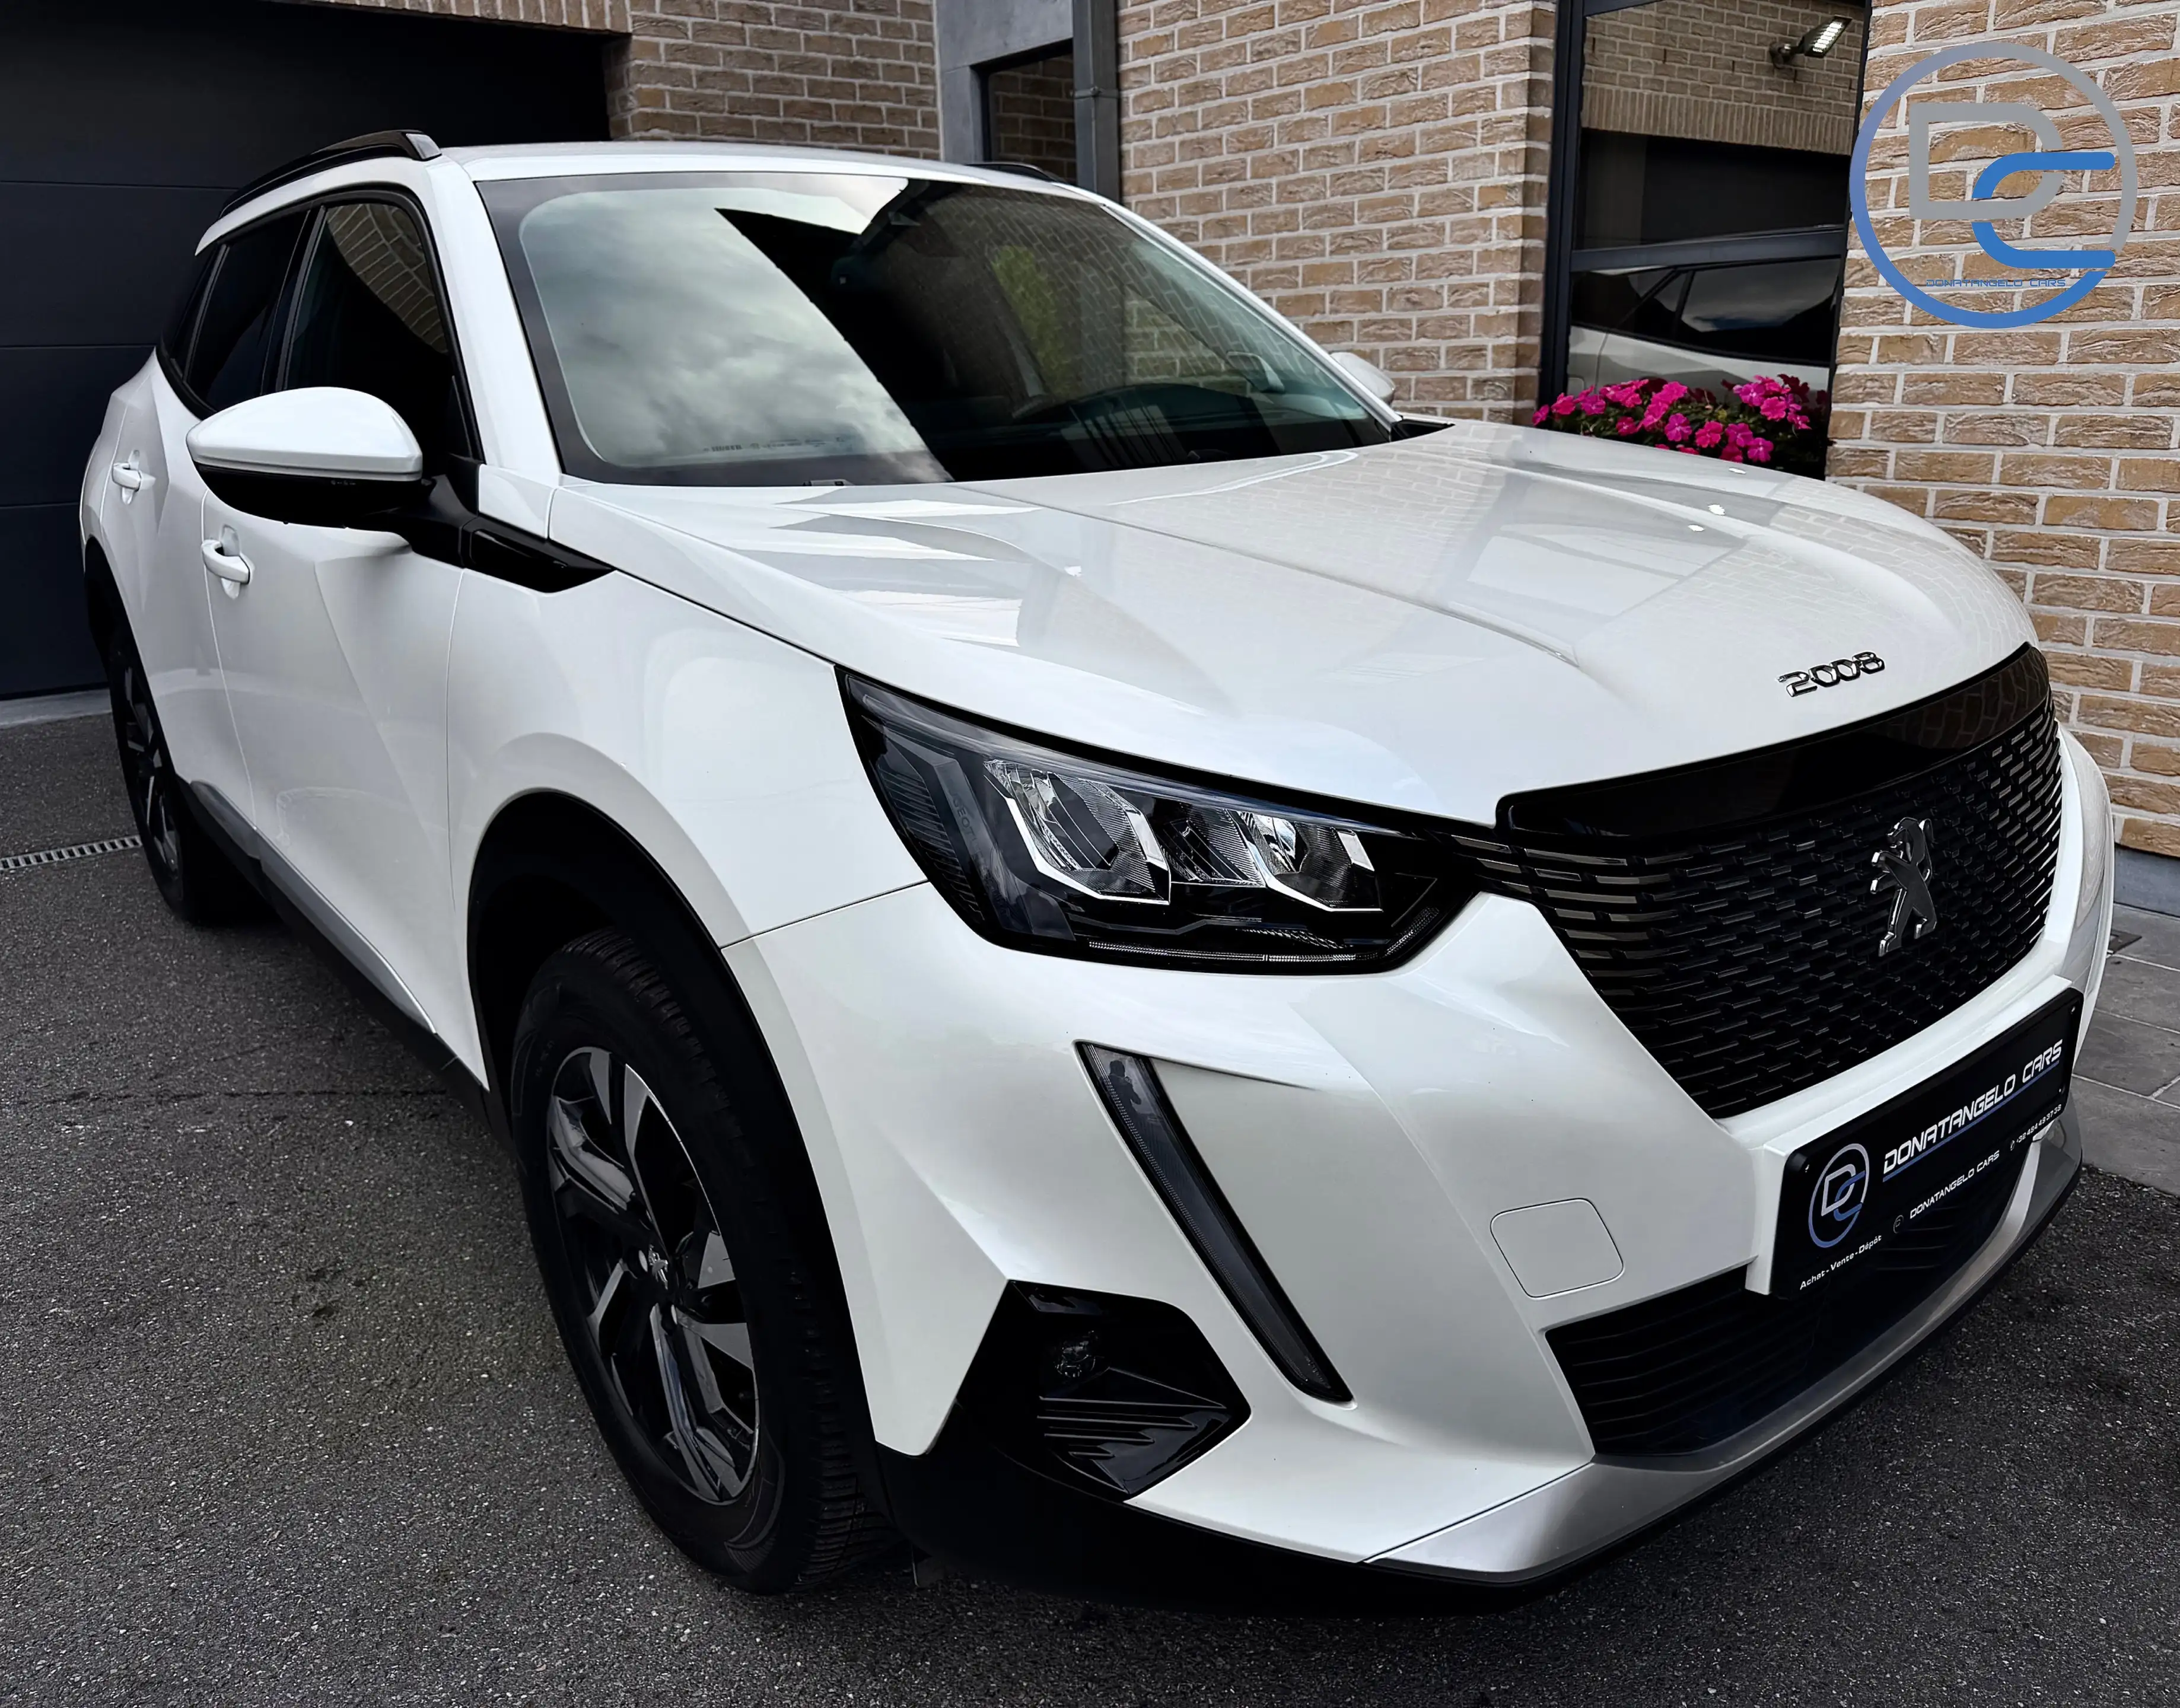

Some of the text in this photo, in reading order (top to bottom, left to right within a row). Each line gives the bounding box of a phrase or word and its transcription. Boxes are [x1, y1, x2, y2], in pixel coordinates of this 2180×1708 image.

[1775, 651, 1885, 697] 2008
[1883, 1039, 2063, 1174] DONATANGELO CARS
[1910, 1150, 2000, 1219] DONATANGELO CARS
